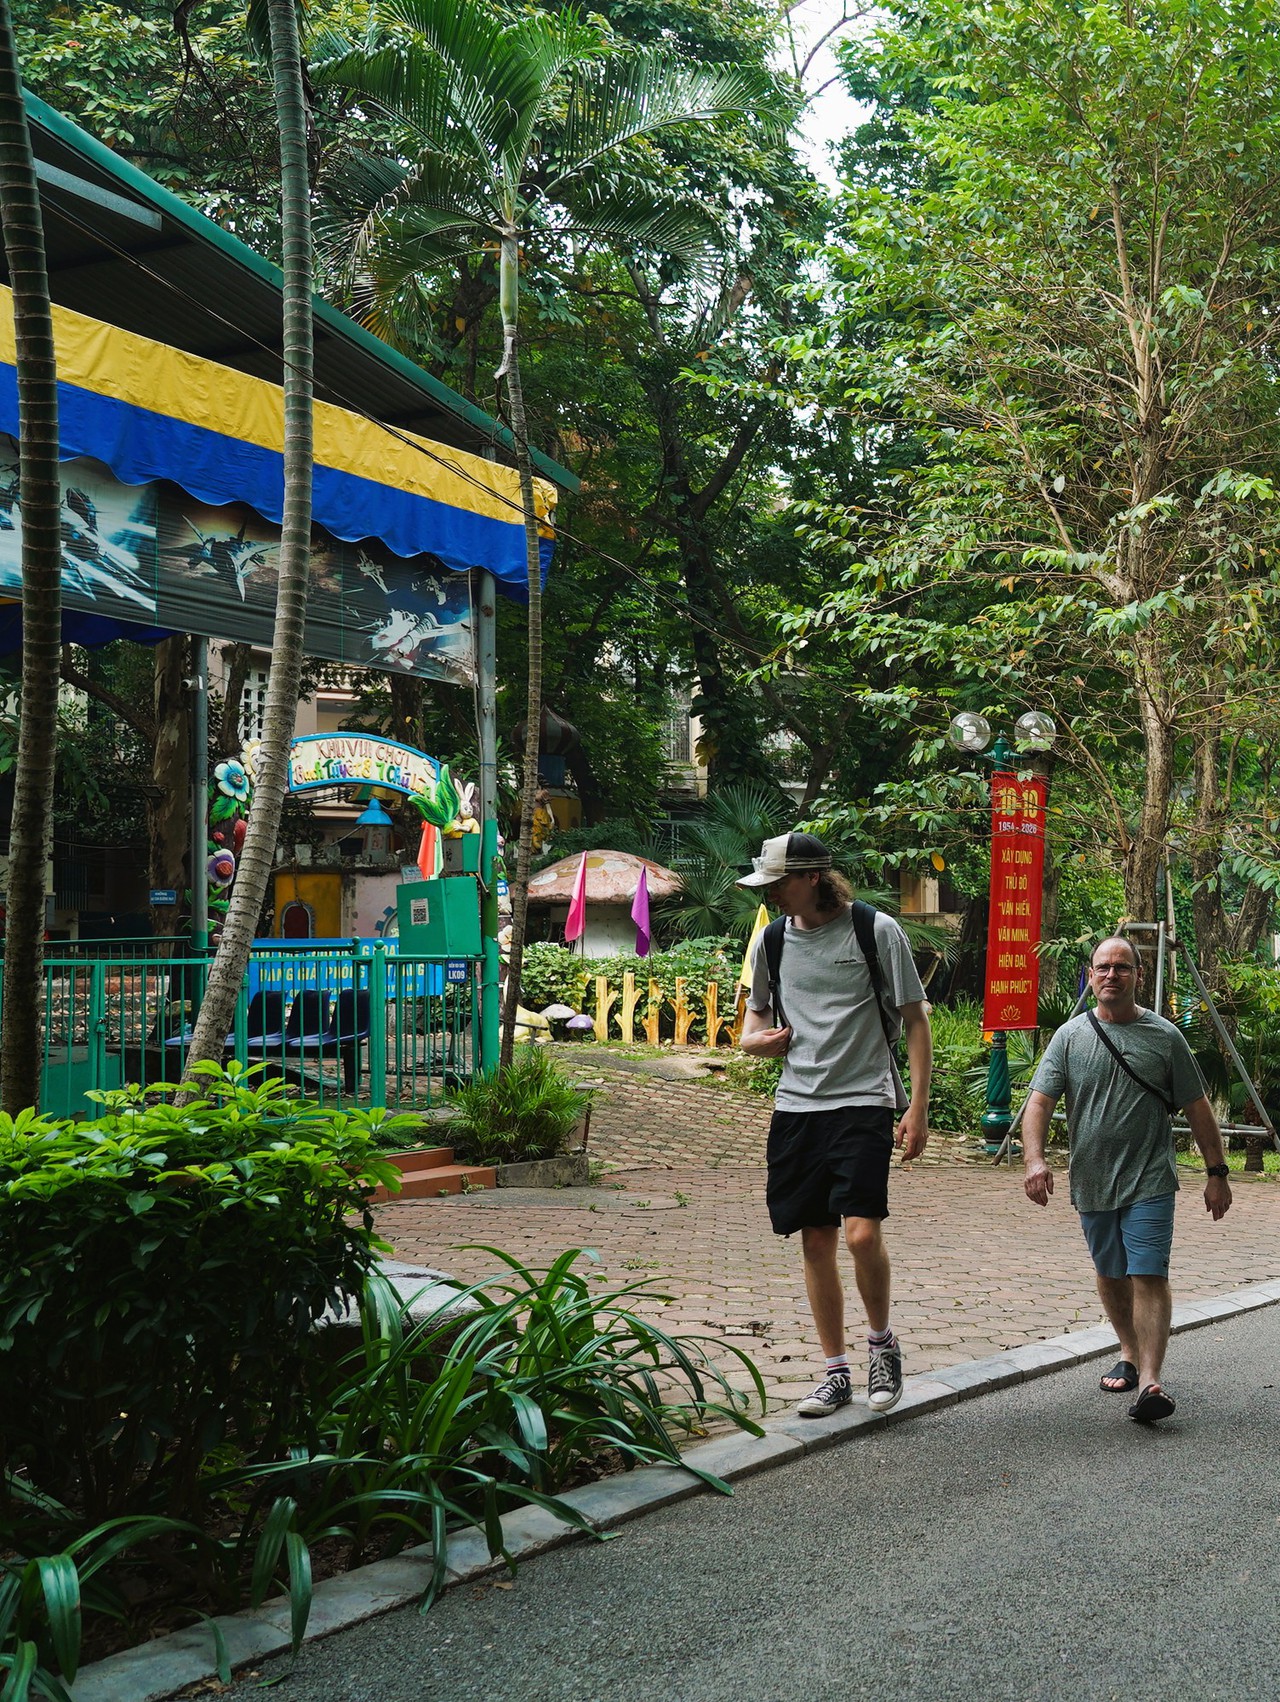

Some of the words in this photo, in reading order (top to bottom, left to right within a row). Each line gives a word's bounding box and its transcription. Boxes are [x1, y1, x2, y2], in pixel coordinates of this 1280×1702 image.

[315, 740, 346, 760] KHU
[346, 740, 373, 759] VUI
[375, 762, 385, 781] 7
[1001, 847, 1015, 864] XÂY
[1005, 872, 1018, 890] THỦ
[1018, 874, 1028, 890] ĐÔ
[998, 926, 1011, 942] VĂN
[998, 951, 1013, 971] HIỆN
[448, 970, 466, 980] LK09
[990, 981, 1010, 997] HẠNH
